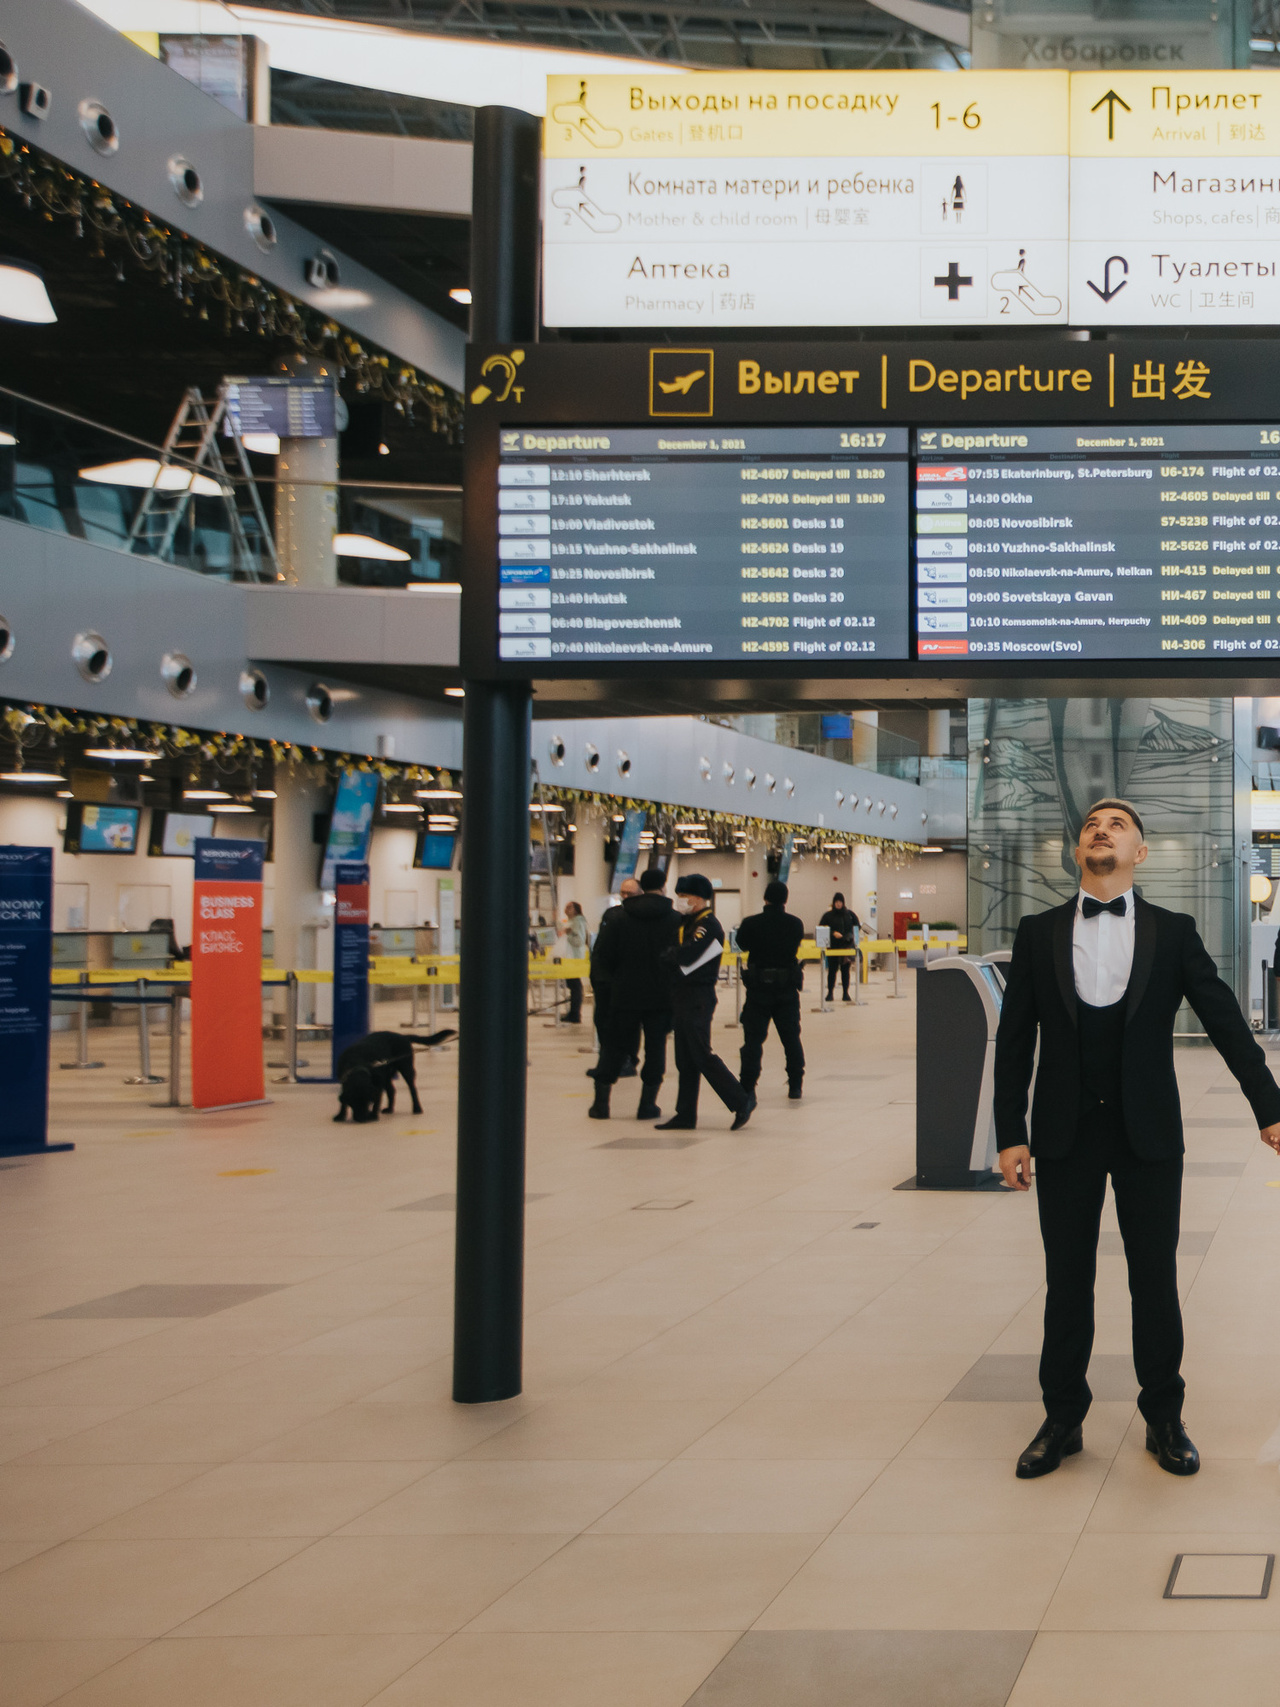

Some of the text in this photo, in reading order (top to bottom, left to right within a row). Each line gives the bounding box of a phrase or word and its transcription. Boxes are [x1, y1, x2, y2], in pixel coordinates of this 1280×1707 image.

[1021, 36, 1184, 67] Хабаровск
[629, 87, 900, 115] Выходы на посадку
[1152, 87, 1262, 115] Прилет
[929, 101, 982, 131] 1-6
[563, 128, 573, 142] 3
[629, 127, 674, 142] Gates
[689, 124, 743, 141] 登机口
[1152, 127, 1207, 141] Arrival
[1230, 124, 1266, 141] 到达
[628, 171, 915, 200] Комната матери и ребенка
[563, 212, 573, 226] 2
[627, 210, 798, 226] Mother & child room
[815, 208, 870, 226] 母婴室
[1152, 209, 1208, 228] Shops,
[627, 256, 731, 279] Аптека
[1151, 254, 1276, 283] Туалеты
[625, 295, 705, 314] Pharmacy
[719, 292, 756, 311] 药店
[1000, 296, 1011, 315] 2
[1151, 293, 1181, 308] WC
[1198, 291, 1254, 308] 卫生间
[737, 361, 859, 395] Вылет
[908, 359, 1092, 402] Departure
[1131, 359, 1211, 401] 出发
[523, 435, 611, 452] Departure
[657, 440, 707, 450] December
[722, 440, 746, 450] 2021
[840, 433, 887, 448] 16:17
[941, 433, 1028, 450] Departure
[1076, 436, 1165, 448] December 1, 2021
[968, 468, 1000, 480] 07:55
[1001, 468, 1075, 481] Ekaterinburg,
[1077, 467, 1153, 480] St.Petersburg
[1160, 466, 1205, 477] U6-174
[1212, 466, 1246, 478] Flight
[1248, 466, 1261, 476] of
[968, 543, 1000, 553] 08:10
[1002, 542, 1116, 553] Yuzhno-Sakhalinsk
[1160, 541, 1209, 551] HZ-5626
[1212, 540, 1246, 552] Flight
[1248, 540, 1261, 550] of
[969, 568, 1000, 578] 08:50
[1001, 567, 1114, 578] Nikolaevsk-na-Amure,
[1116, 566, 1153, 577] Nelkan
[1161, 565, 1206, 576] НИ-415
[1212, 566, 1254, 577] Delayed
[1256, 566, 1271, 575] till
[584, 617, 682, 631] Blagoveschensk
[742, 617, 789, 627] HZ-4702
[793, 616, 827, 629] Flight
[829, 616, 841, 627] of
[844, 616, 875, 627] 02.12
[969, 642, 1000, 652] 09:35
[1002, 640, 1082, 653] Moscow(Svo)
[1161, 640, 1206, 650] N4-306
[1213, 640, 1246, 651] Flight
[1249, 640, 1262, 649] of
[200, 896, 254, 908] BUSINESS
[201, 908, 235, 919] CLASS
